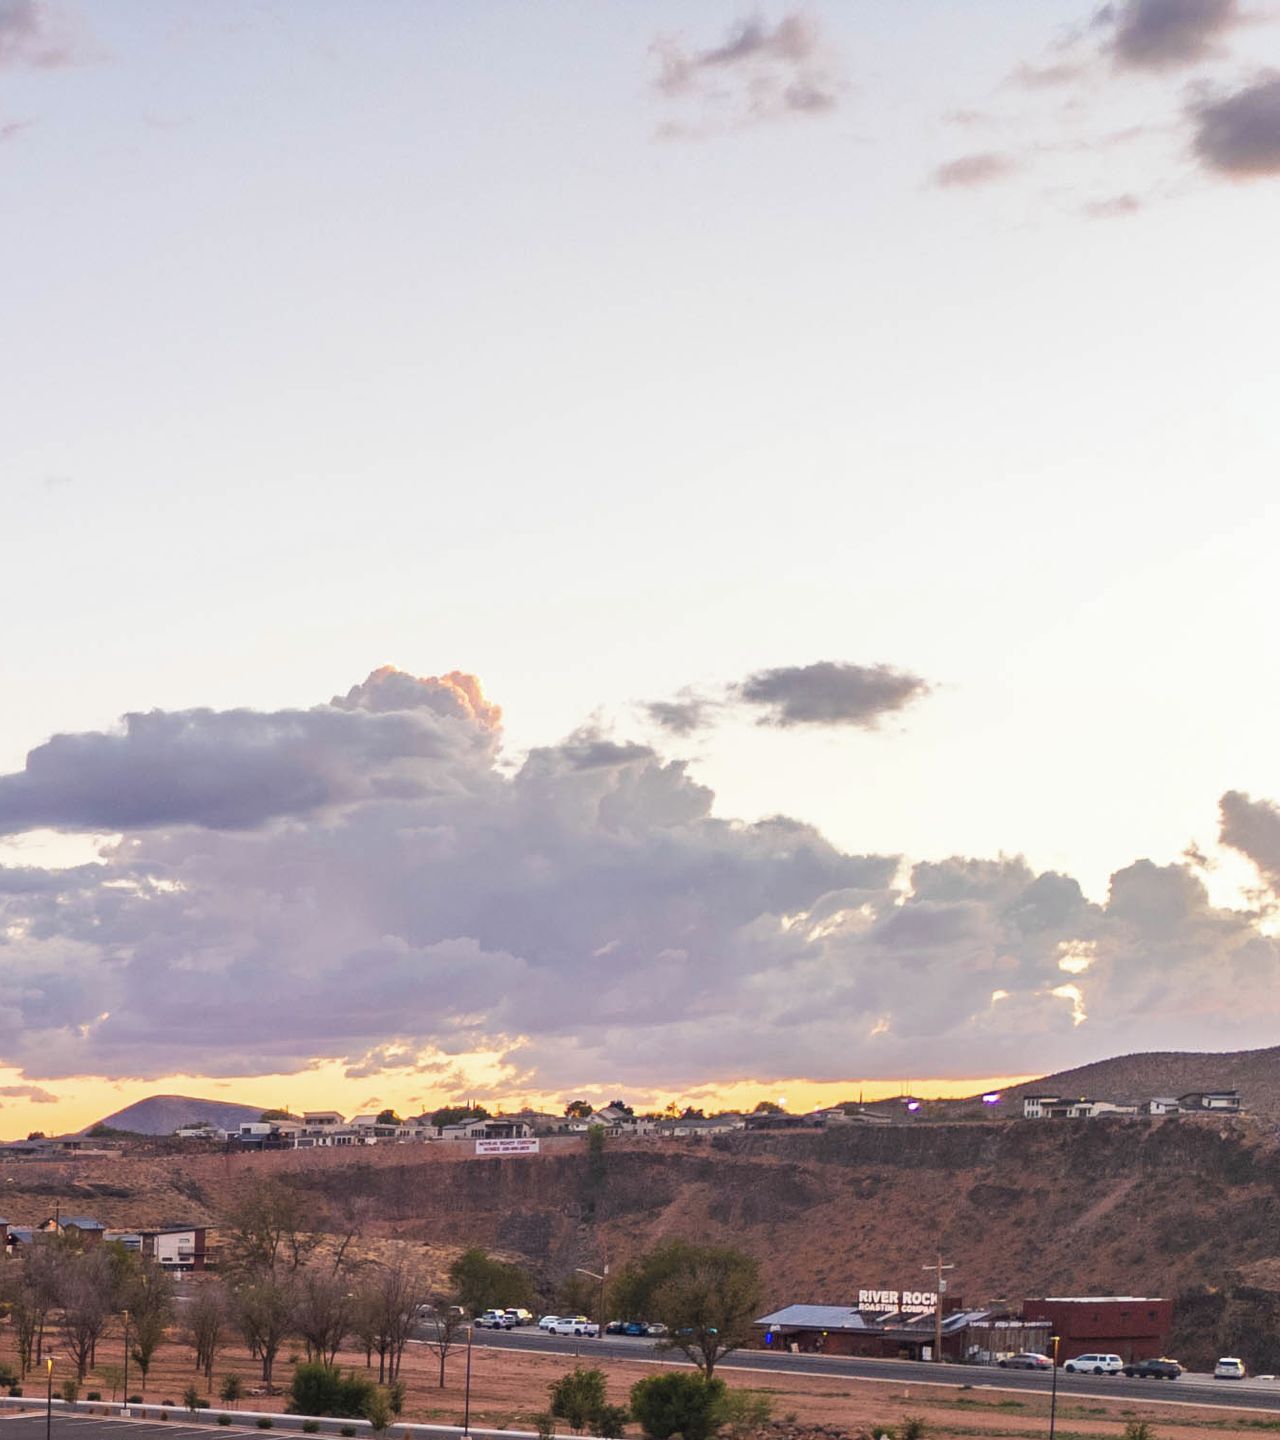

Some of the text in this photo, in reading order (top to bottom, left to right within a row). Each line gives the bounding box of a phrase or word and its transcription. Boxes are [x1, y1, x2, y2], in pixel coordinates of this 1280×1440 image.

[858, 1290, 937, 1304] RIVER ROCK
[858, 1303, 898, 1313] ROASTING
